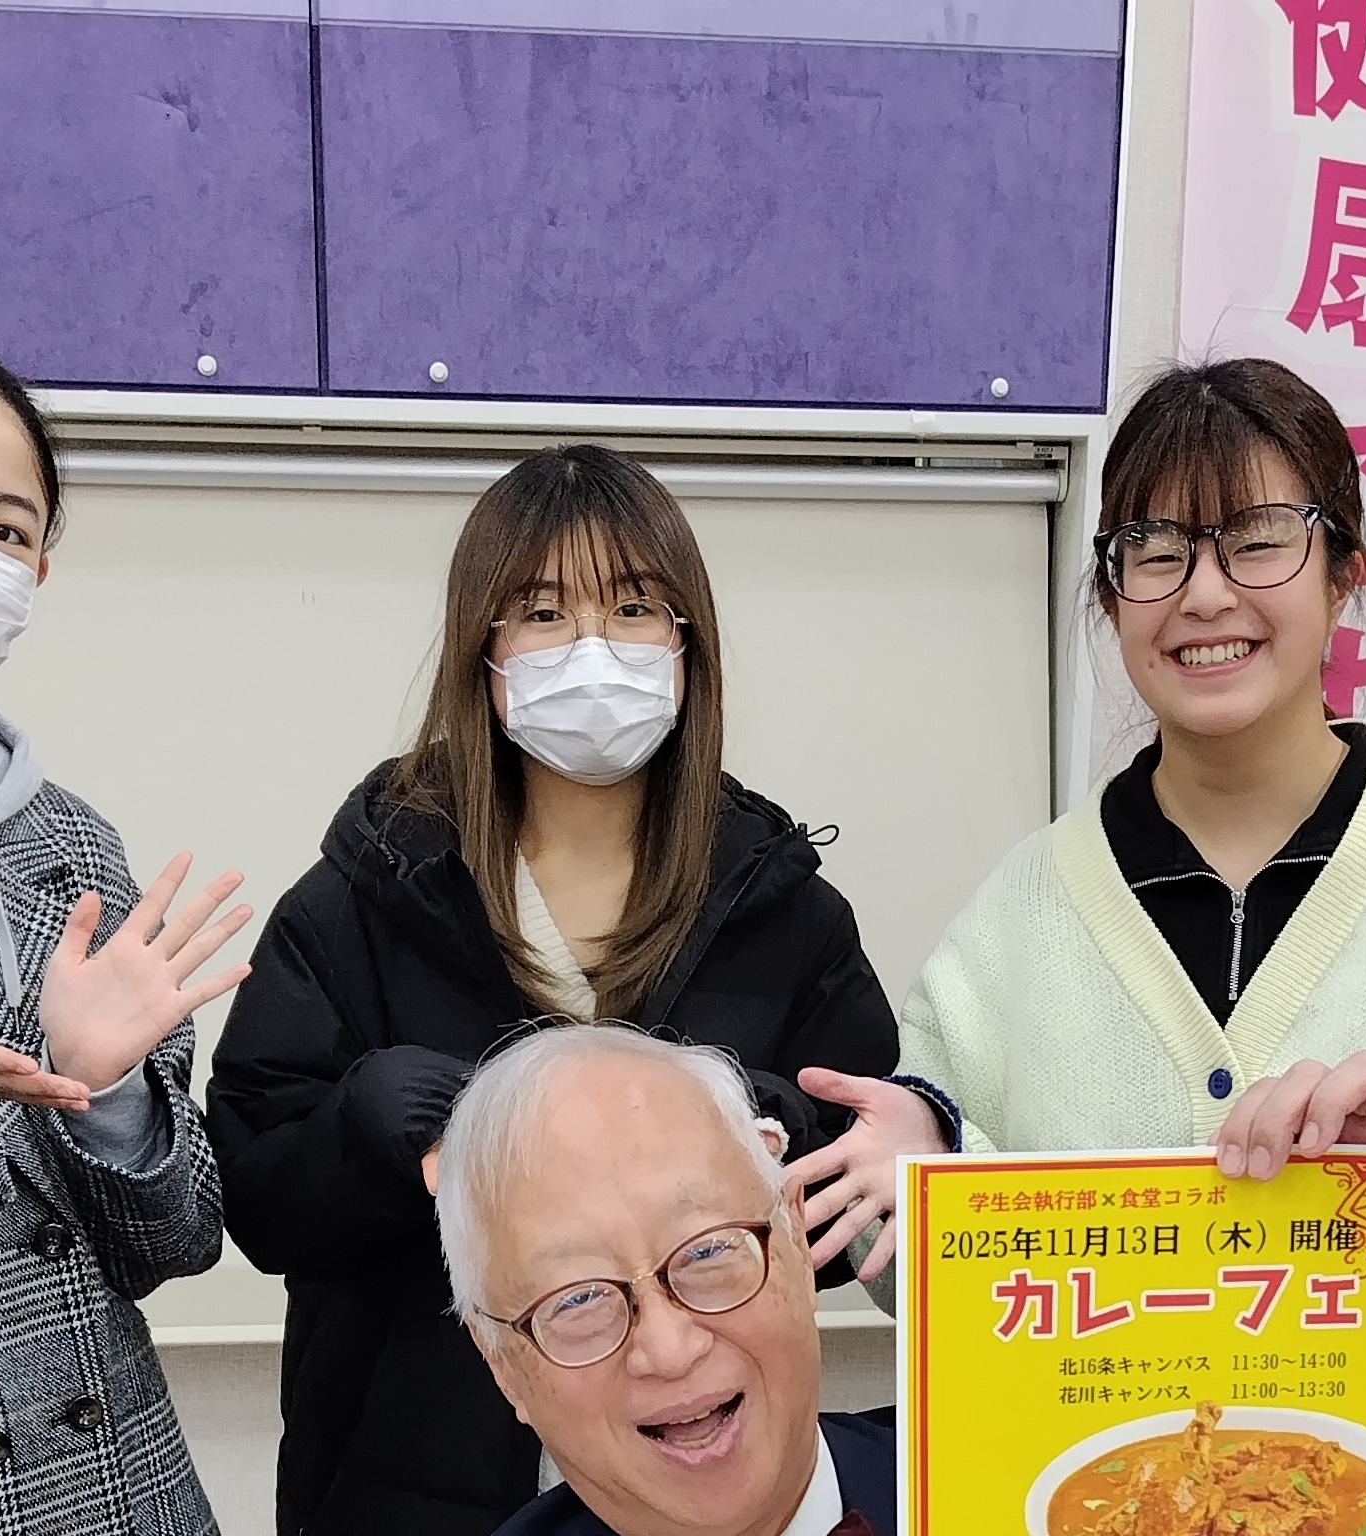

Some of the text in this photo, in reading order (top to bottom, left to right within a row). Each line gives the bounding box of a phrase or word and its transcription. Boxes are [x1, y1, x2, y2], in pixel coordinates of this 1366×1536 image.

[968, 1186, 1227, 1213] 学生会執行部×食堂コラボ
[1059, 1356, 1211, 1376] 北16条キャンパス
[1059, 1385, 1191, 1404] 花川キャンパス
